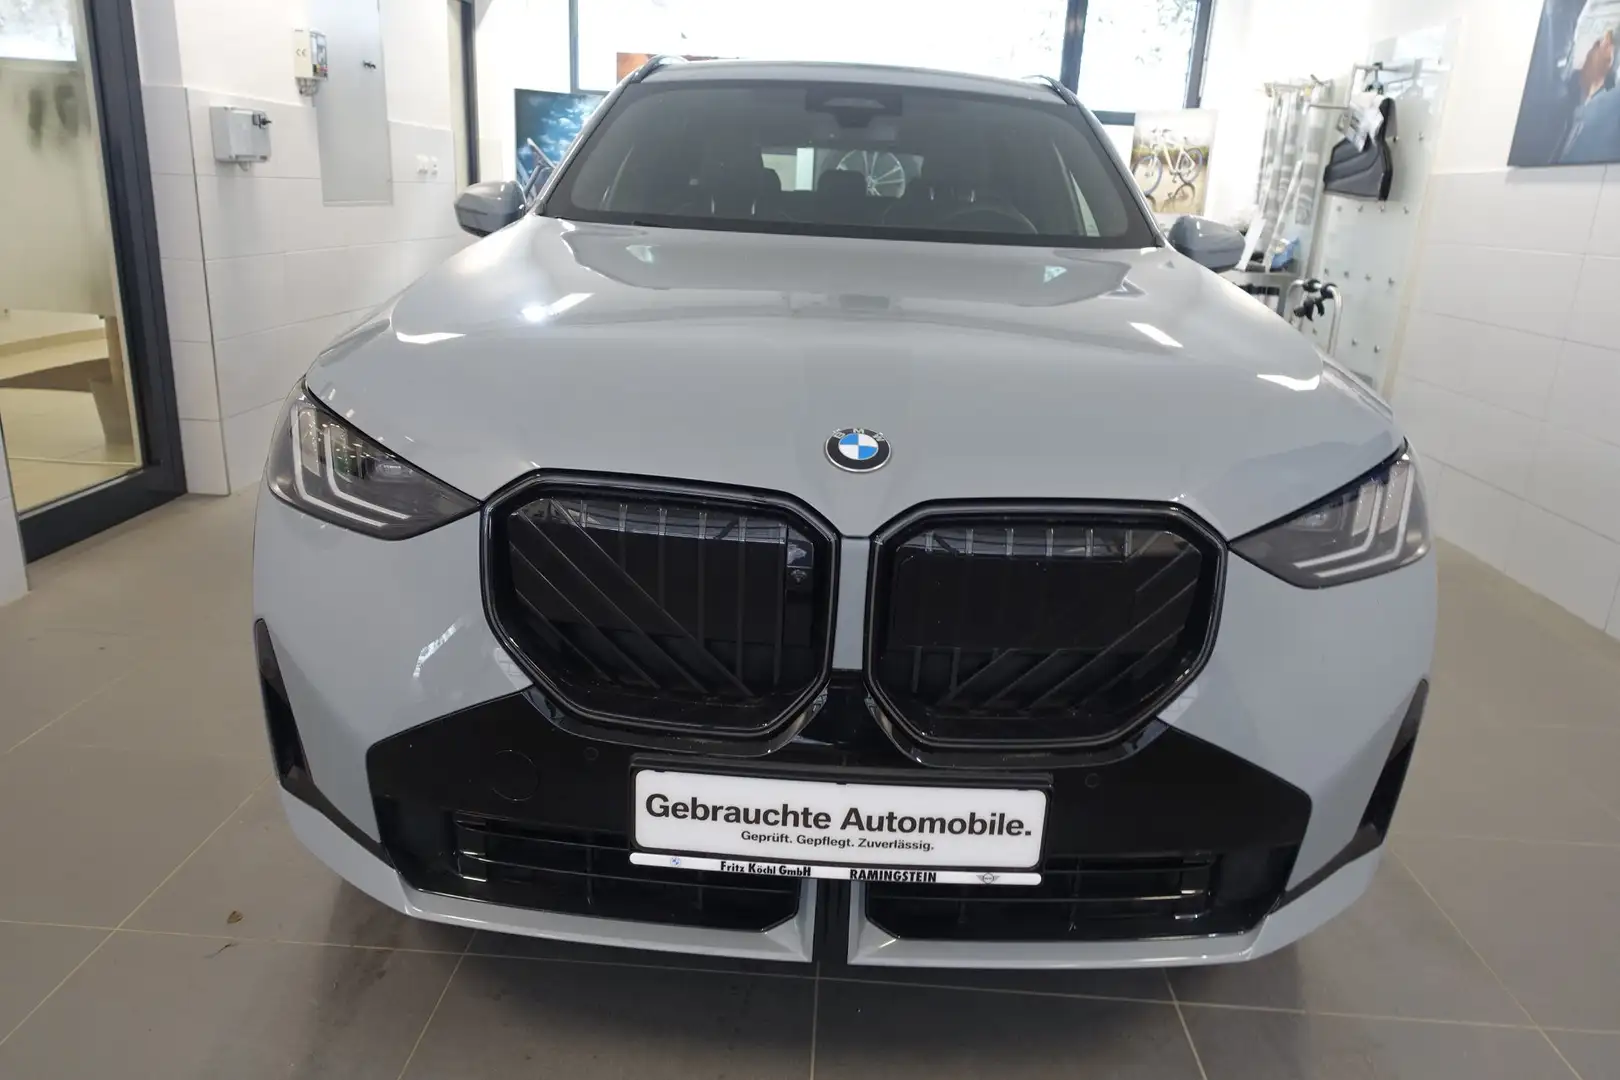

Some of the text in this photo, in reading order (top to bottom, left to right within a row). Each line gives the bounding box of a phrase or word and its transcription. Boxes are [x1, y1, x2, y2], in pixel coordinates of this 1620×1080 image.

[645, 793, 1032, 836] Gebrauchte Automobile.
[741, 830, 934, 852] Geprüft. Gepflegt. Zuverlässig.
[720, 861, 937, 883] Fritz Köchl GmbH RAMINGSTEIN
